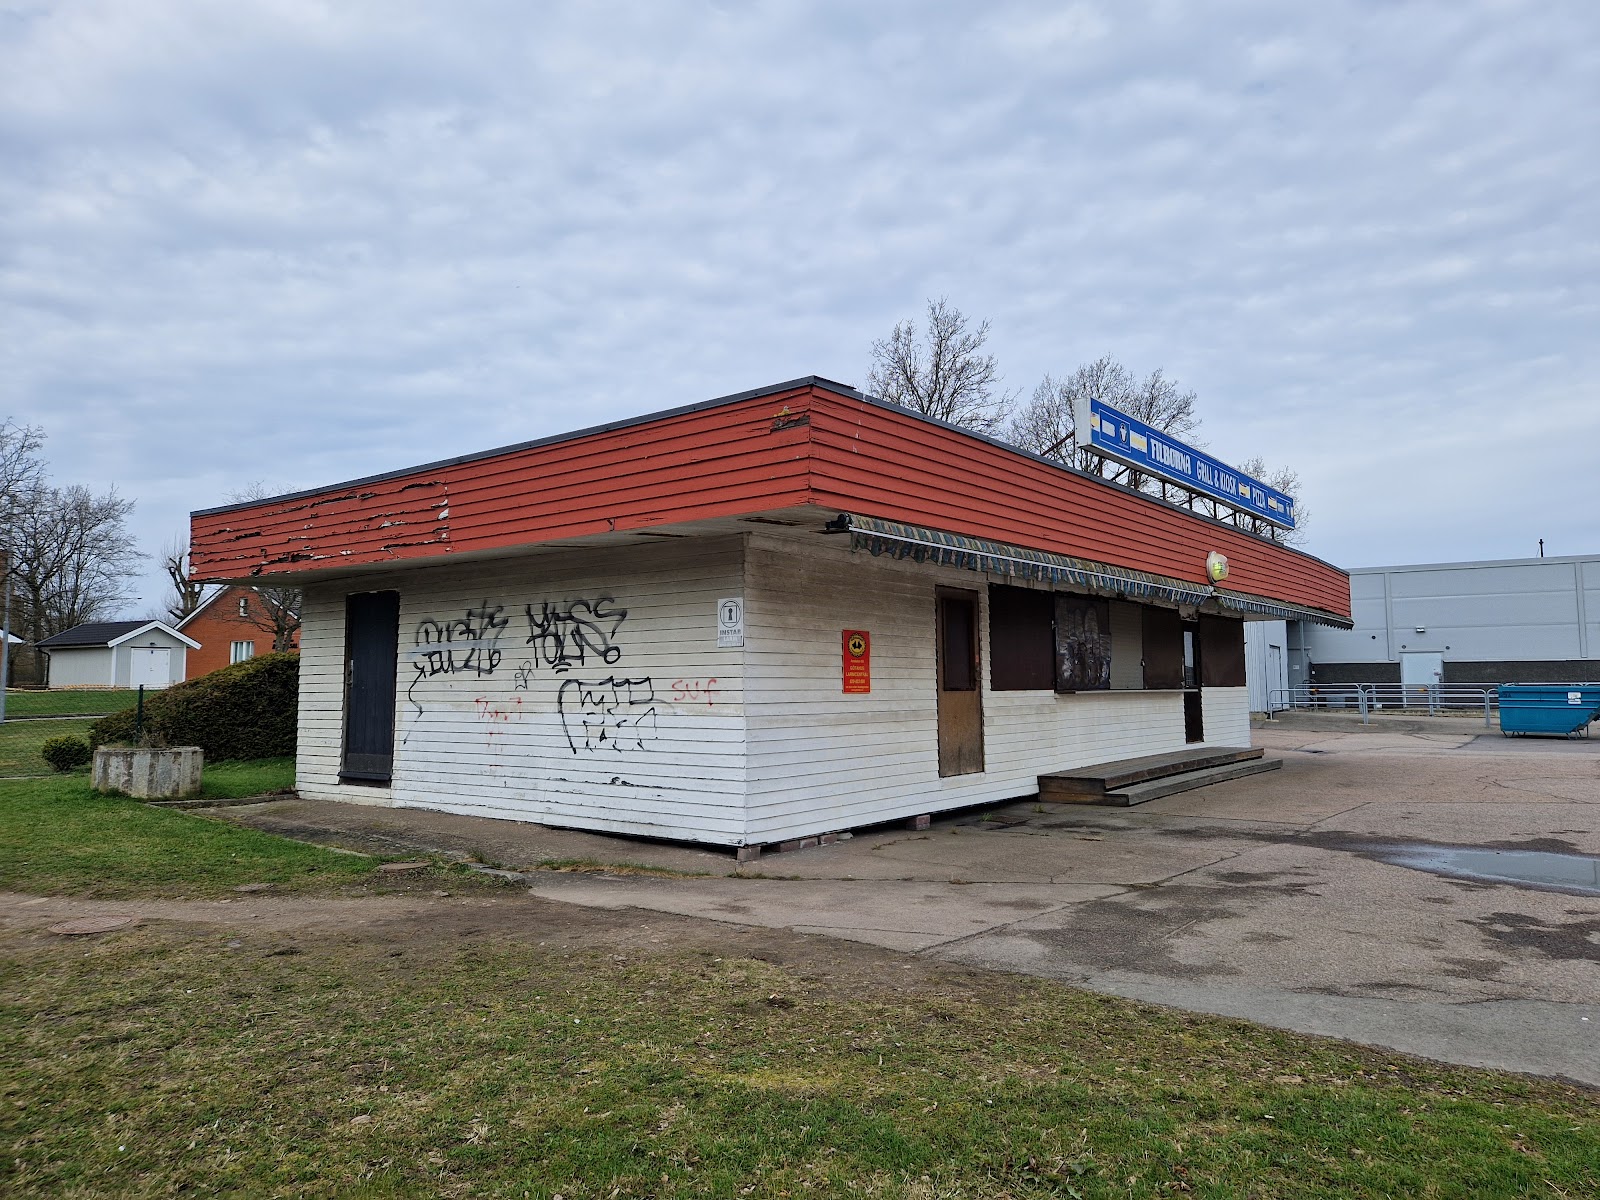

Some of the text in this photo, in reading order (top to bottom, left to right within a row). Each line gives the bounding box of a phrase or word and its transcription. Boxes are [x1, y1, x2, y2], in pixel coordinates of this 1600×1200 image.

[1196, 460, 1213, 486] GRILL
[1214, 470, 1219, 488] &
[1219, 471, 1236, 495] KIOSK
[1252, 487, 1267, 509] PIZZA
